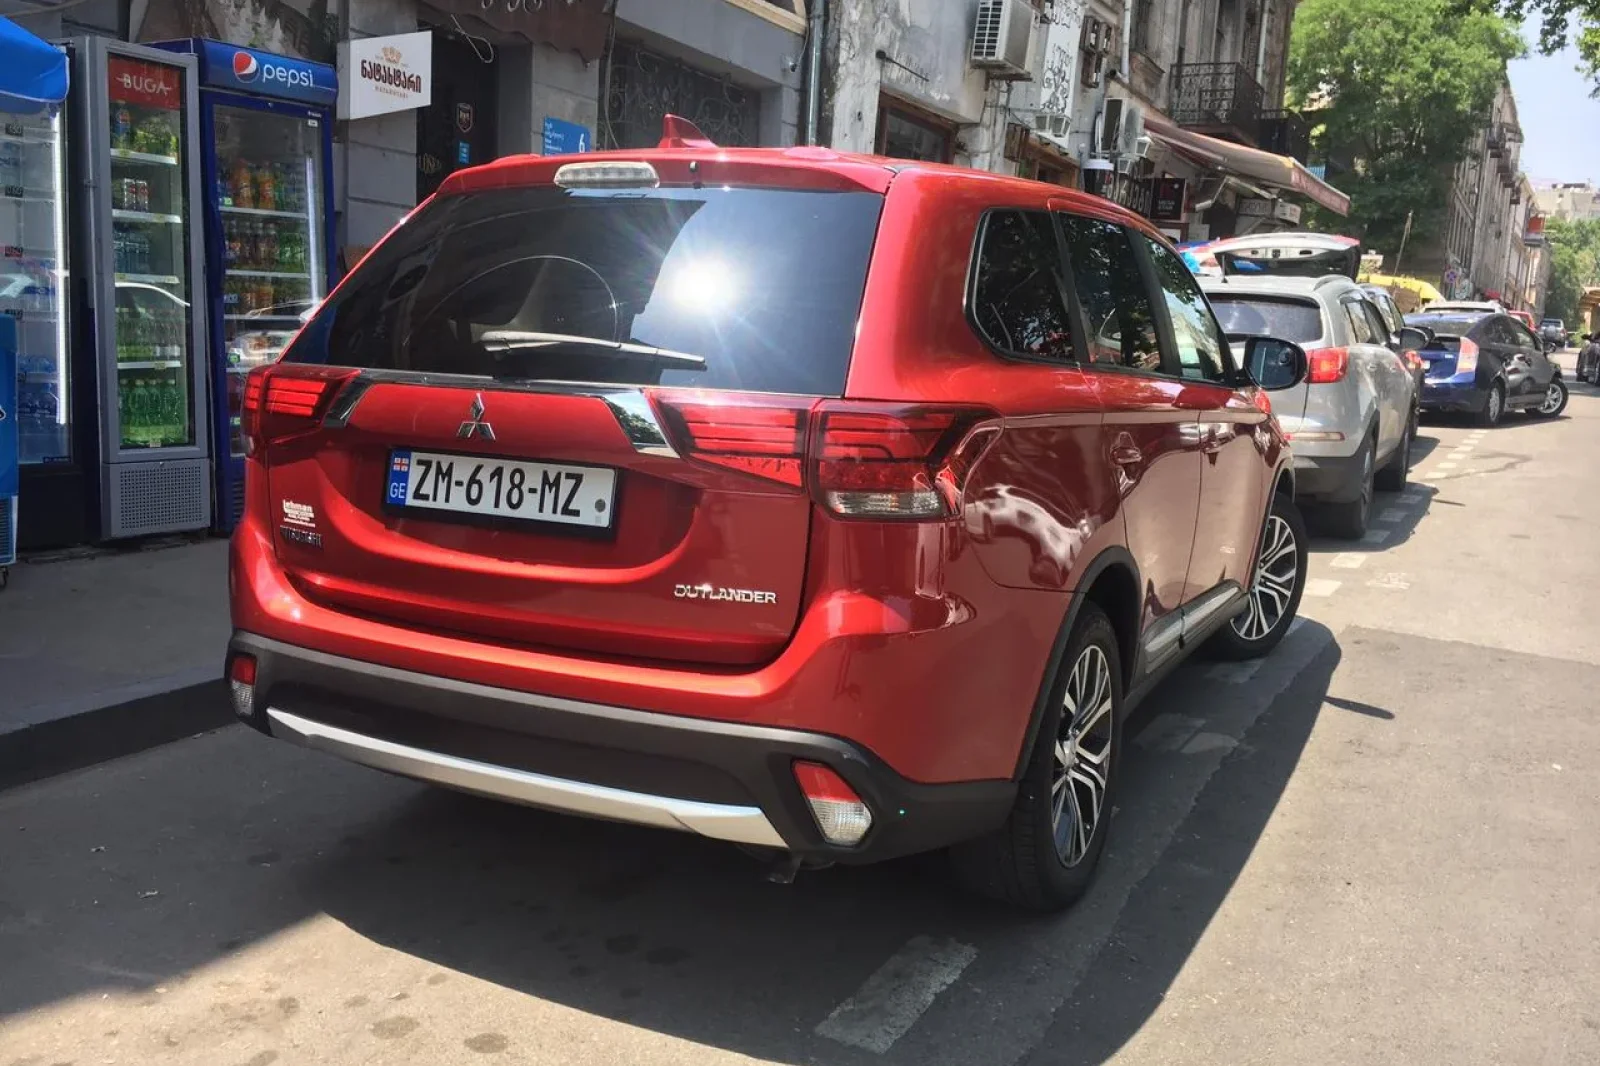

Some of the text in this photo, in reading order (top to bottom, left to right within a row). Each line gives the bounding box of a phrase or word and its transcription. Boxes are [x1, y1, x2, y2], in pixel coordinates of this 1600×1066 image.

[122, 73, 168, 96] BUGA
[262, 64, 314, 88] pepsi
[361, 59, 422, 93] ნატახტარი
[389, 482, 406, 499] GE
[412, 459, 584, 518] ZM-618-MZ
[674, 583, 777, 604] OUTLANDER
